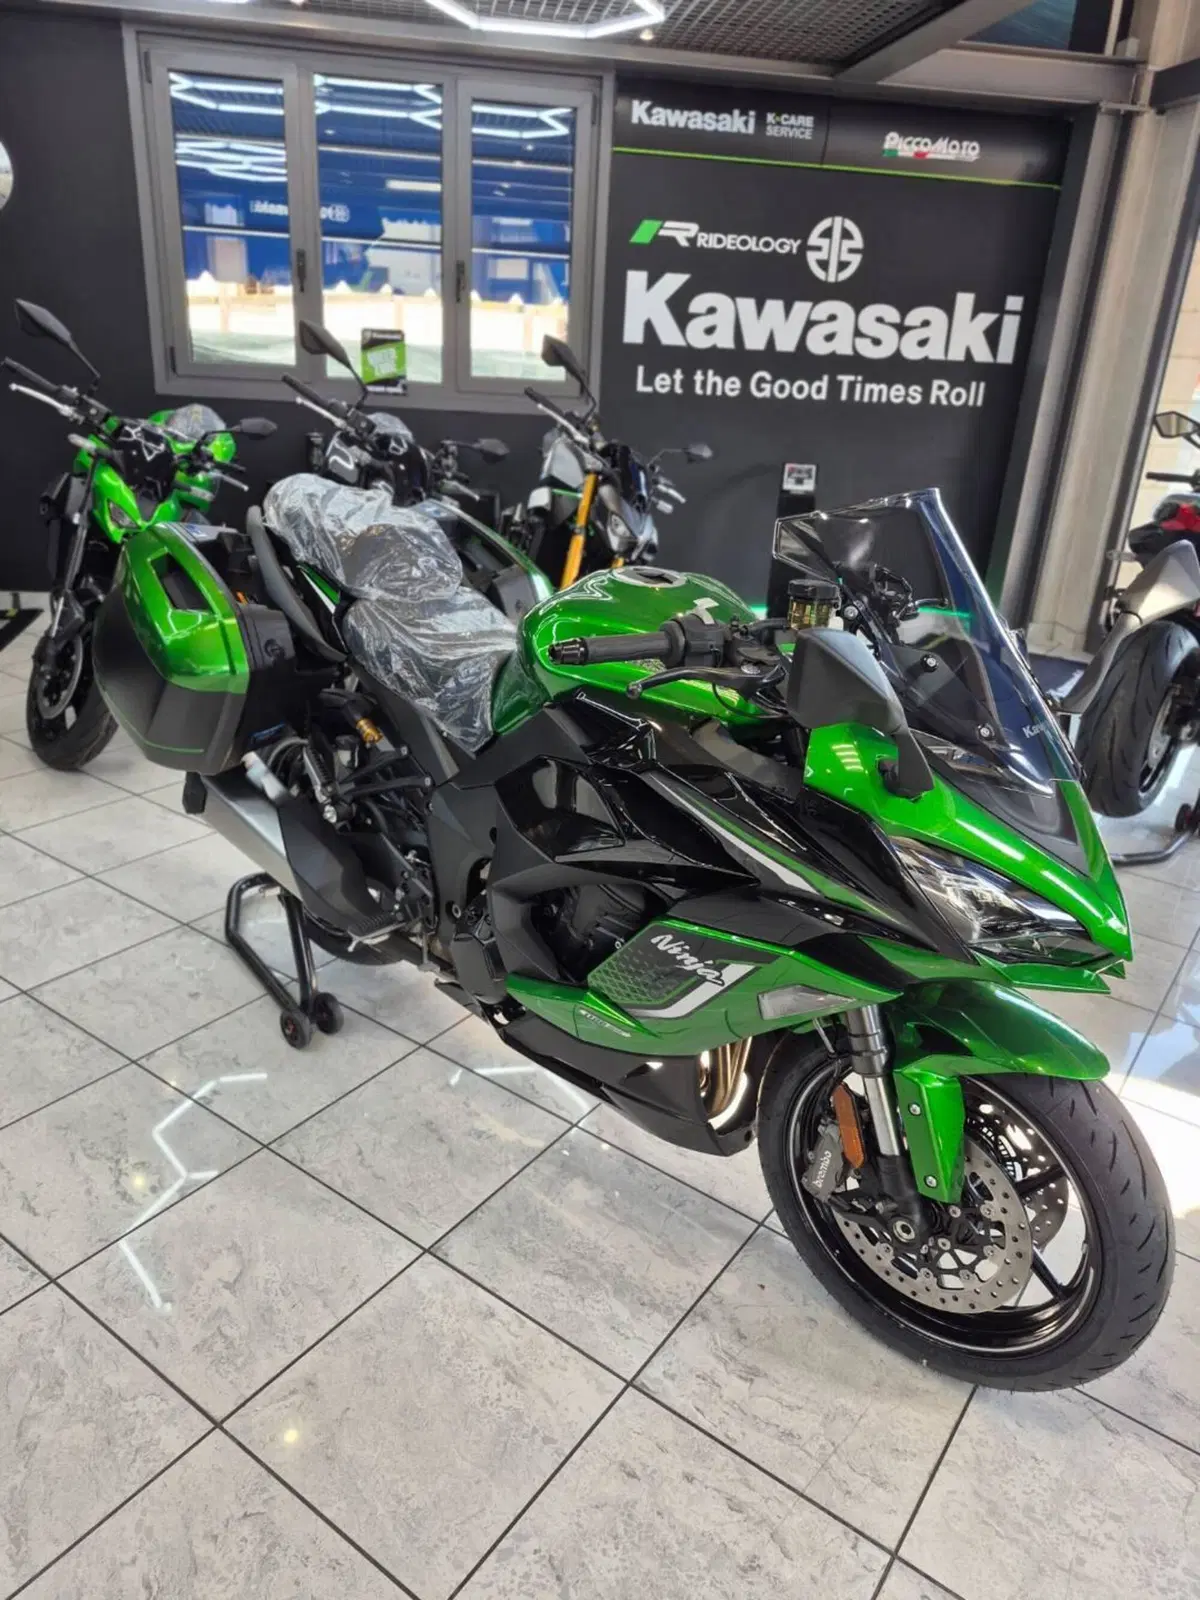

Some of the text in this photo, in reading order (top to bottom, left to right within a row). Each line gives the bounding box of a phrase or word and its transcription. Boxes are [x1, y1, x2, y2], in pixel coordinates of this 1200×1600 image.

[631, 99, 757, 135] Kawasaki
[765, 124, 813, 140] SERVICE
[696, 232, 801, 255] RIDEOLOGY
[622, 270, 1025, 365] Kawasaki
[636, 365, 986, 408] Let the Good Times Roll
[650, 933, 725, 987] Ninja
[811, 1150, 833, 1189] brembo
